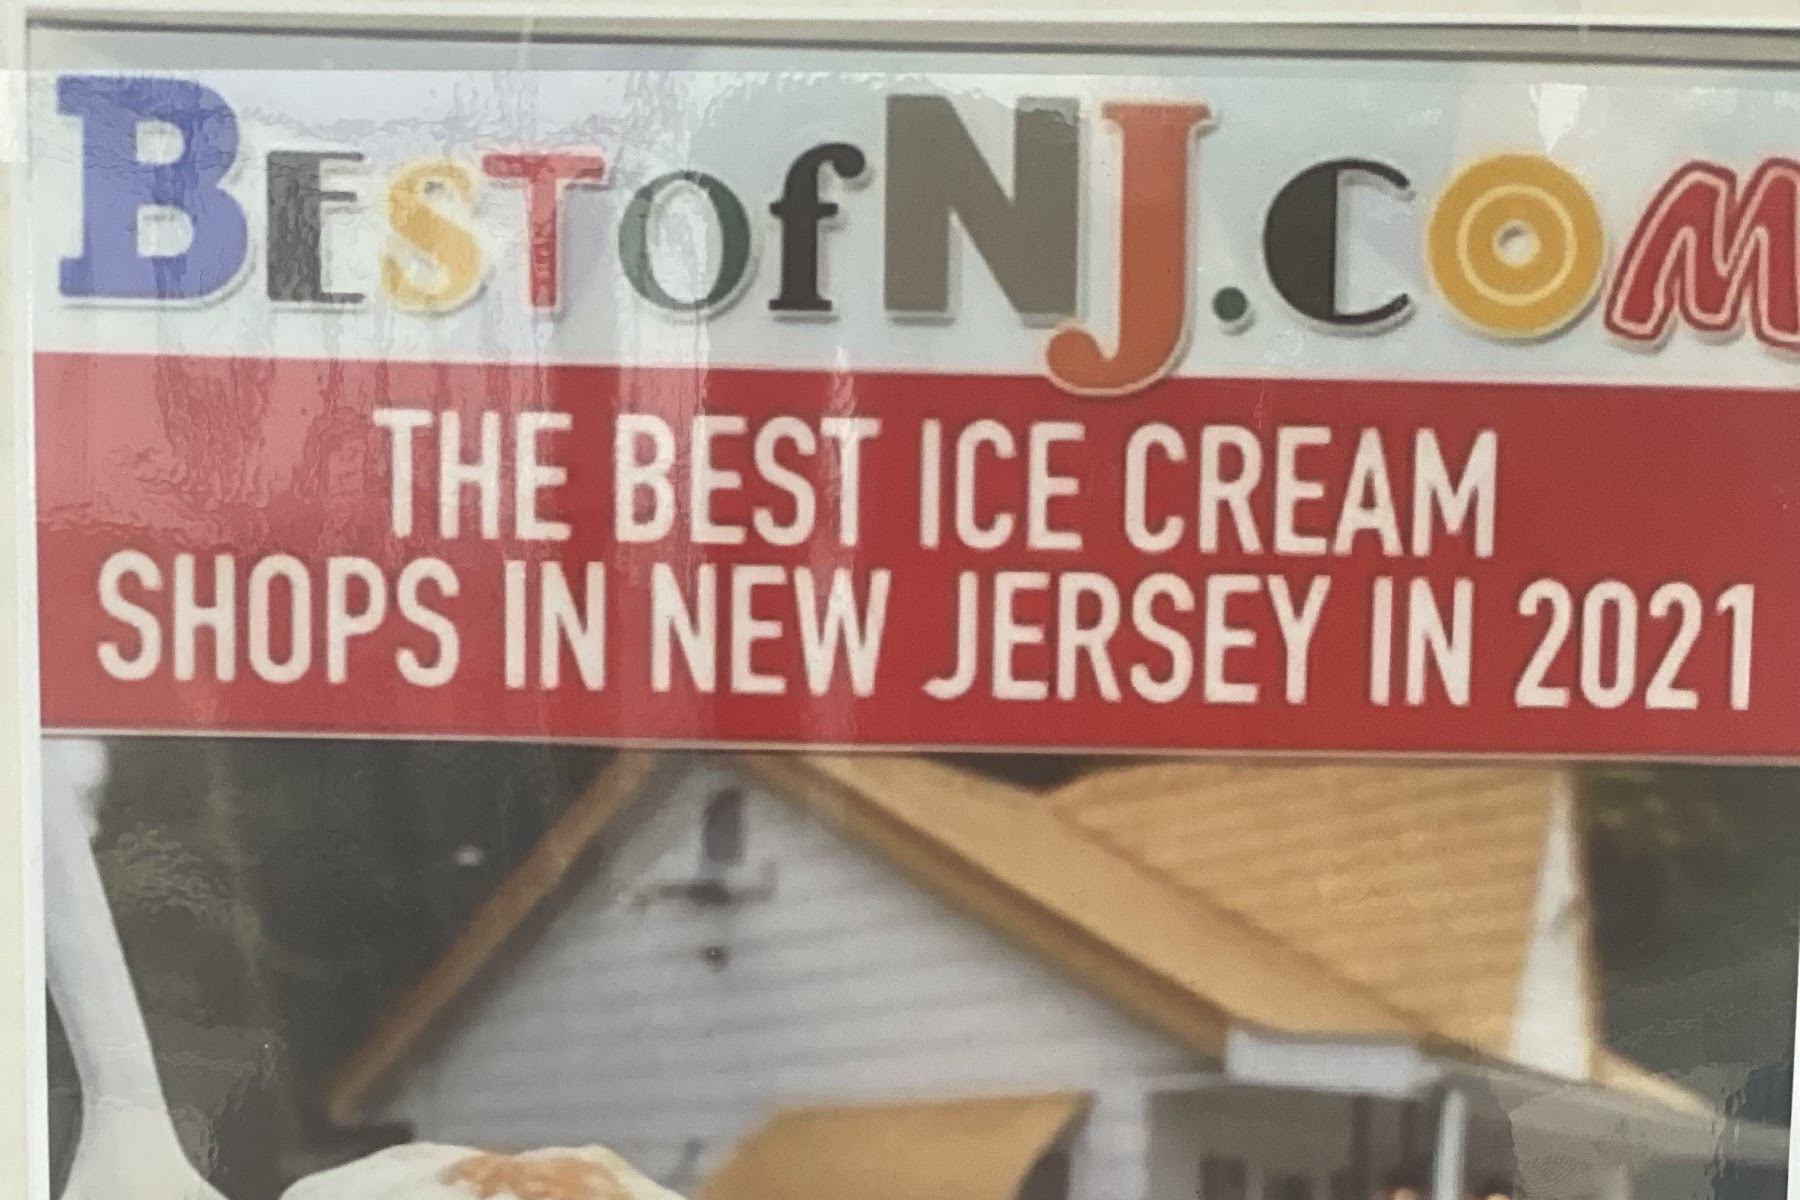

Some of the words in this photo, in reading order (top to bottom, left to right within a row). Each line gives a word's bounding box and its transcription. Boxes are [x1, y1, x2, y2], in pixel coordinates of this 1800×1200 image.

[373, 408, 572, 541] THE
[613, 412, 882, 547] BEST
[918, 418, 1086, 551] ICE
[1122, 420, 1498, 558] CREAM
[96, 548, 461, 688] SHOPS
[503, 560, 606, 692] IN
[650, 561, 892, 698] NEW
[923, 570, 1332, 706] JERSEY
[1370, 575, 1475, 707] IN
[1513, 578, 1756, 712] 2021
